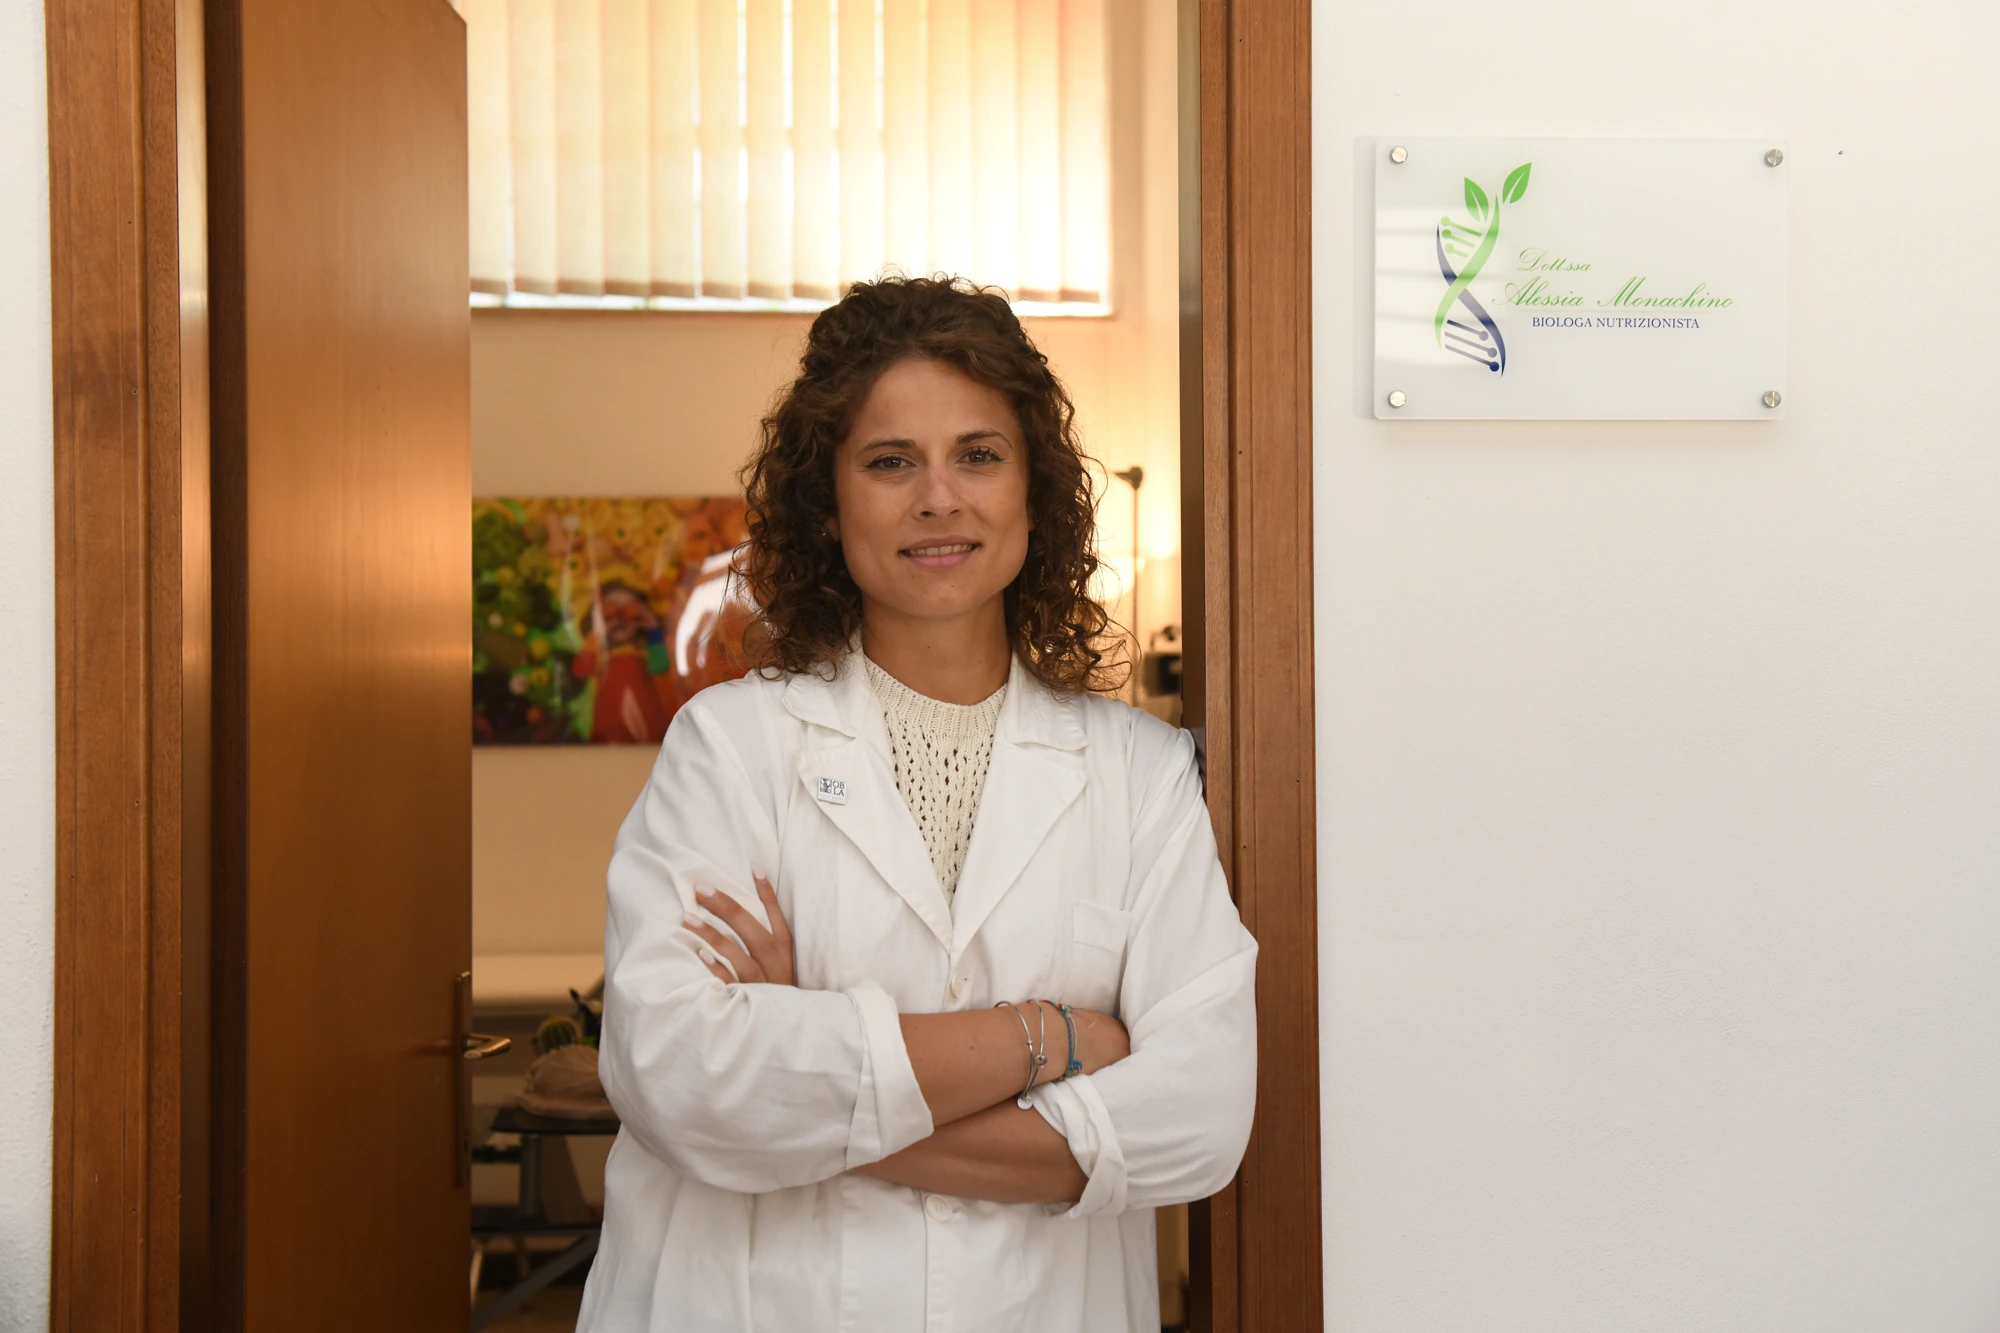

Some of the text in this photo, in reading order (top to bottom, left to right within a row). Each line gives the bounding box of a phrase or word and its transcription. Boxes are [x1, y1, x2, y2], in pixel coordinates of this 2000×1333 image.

[1517, 247, 1591, 272] Dott.ssa
[1492, 275, 1733, 308] Alessia Monachino
[1532, 317, 1700, 329] BIOLOGA NUTRIZIONISTA
